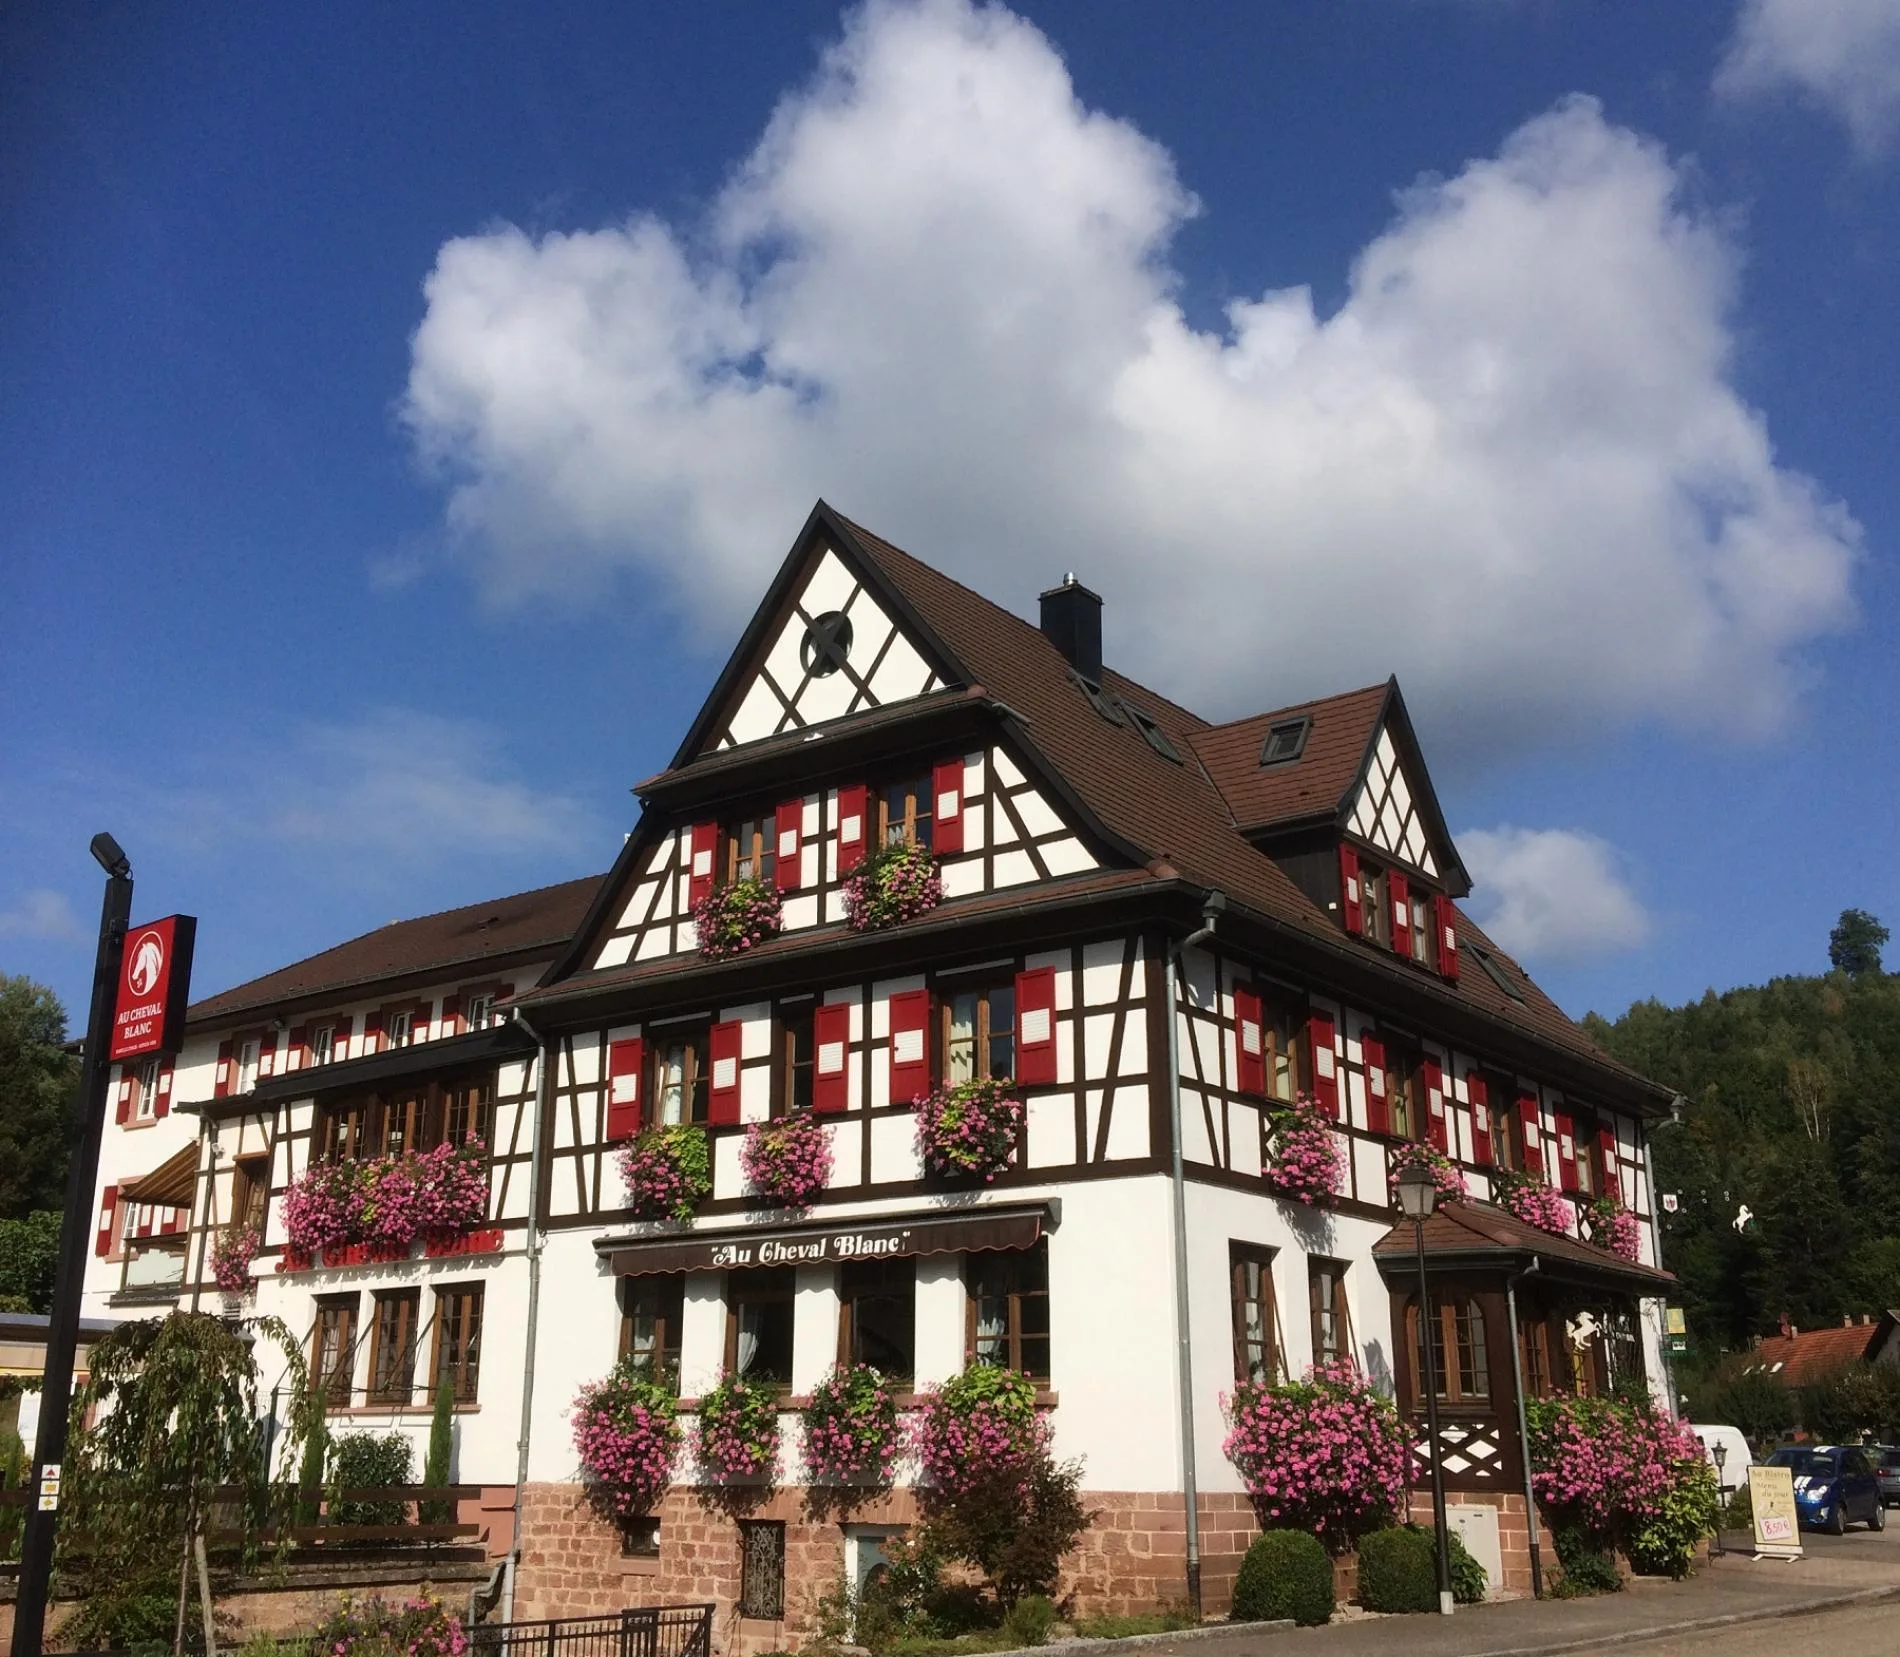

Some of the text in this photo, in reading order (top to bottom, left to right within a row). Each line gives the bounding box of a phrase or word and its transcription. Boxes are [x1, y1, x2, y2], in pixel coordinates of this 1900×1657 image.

[117, 1002, 162, 1025] AU CHEVAL
[123, 1021, 152, 1039] BLANC
[759, 1238, 827, 1263] Cheval
